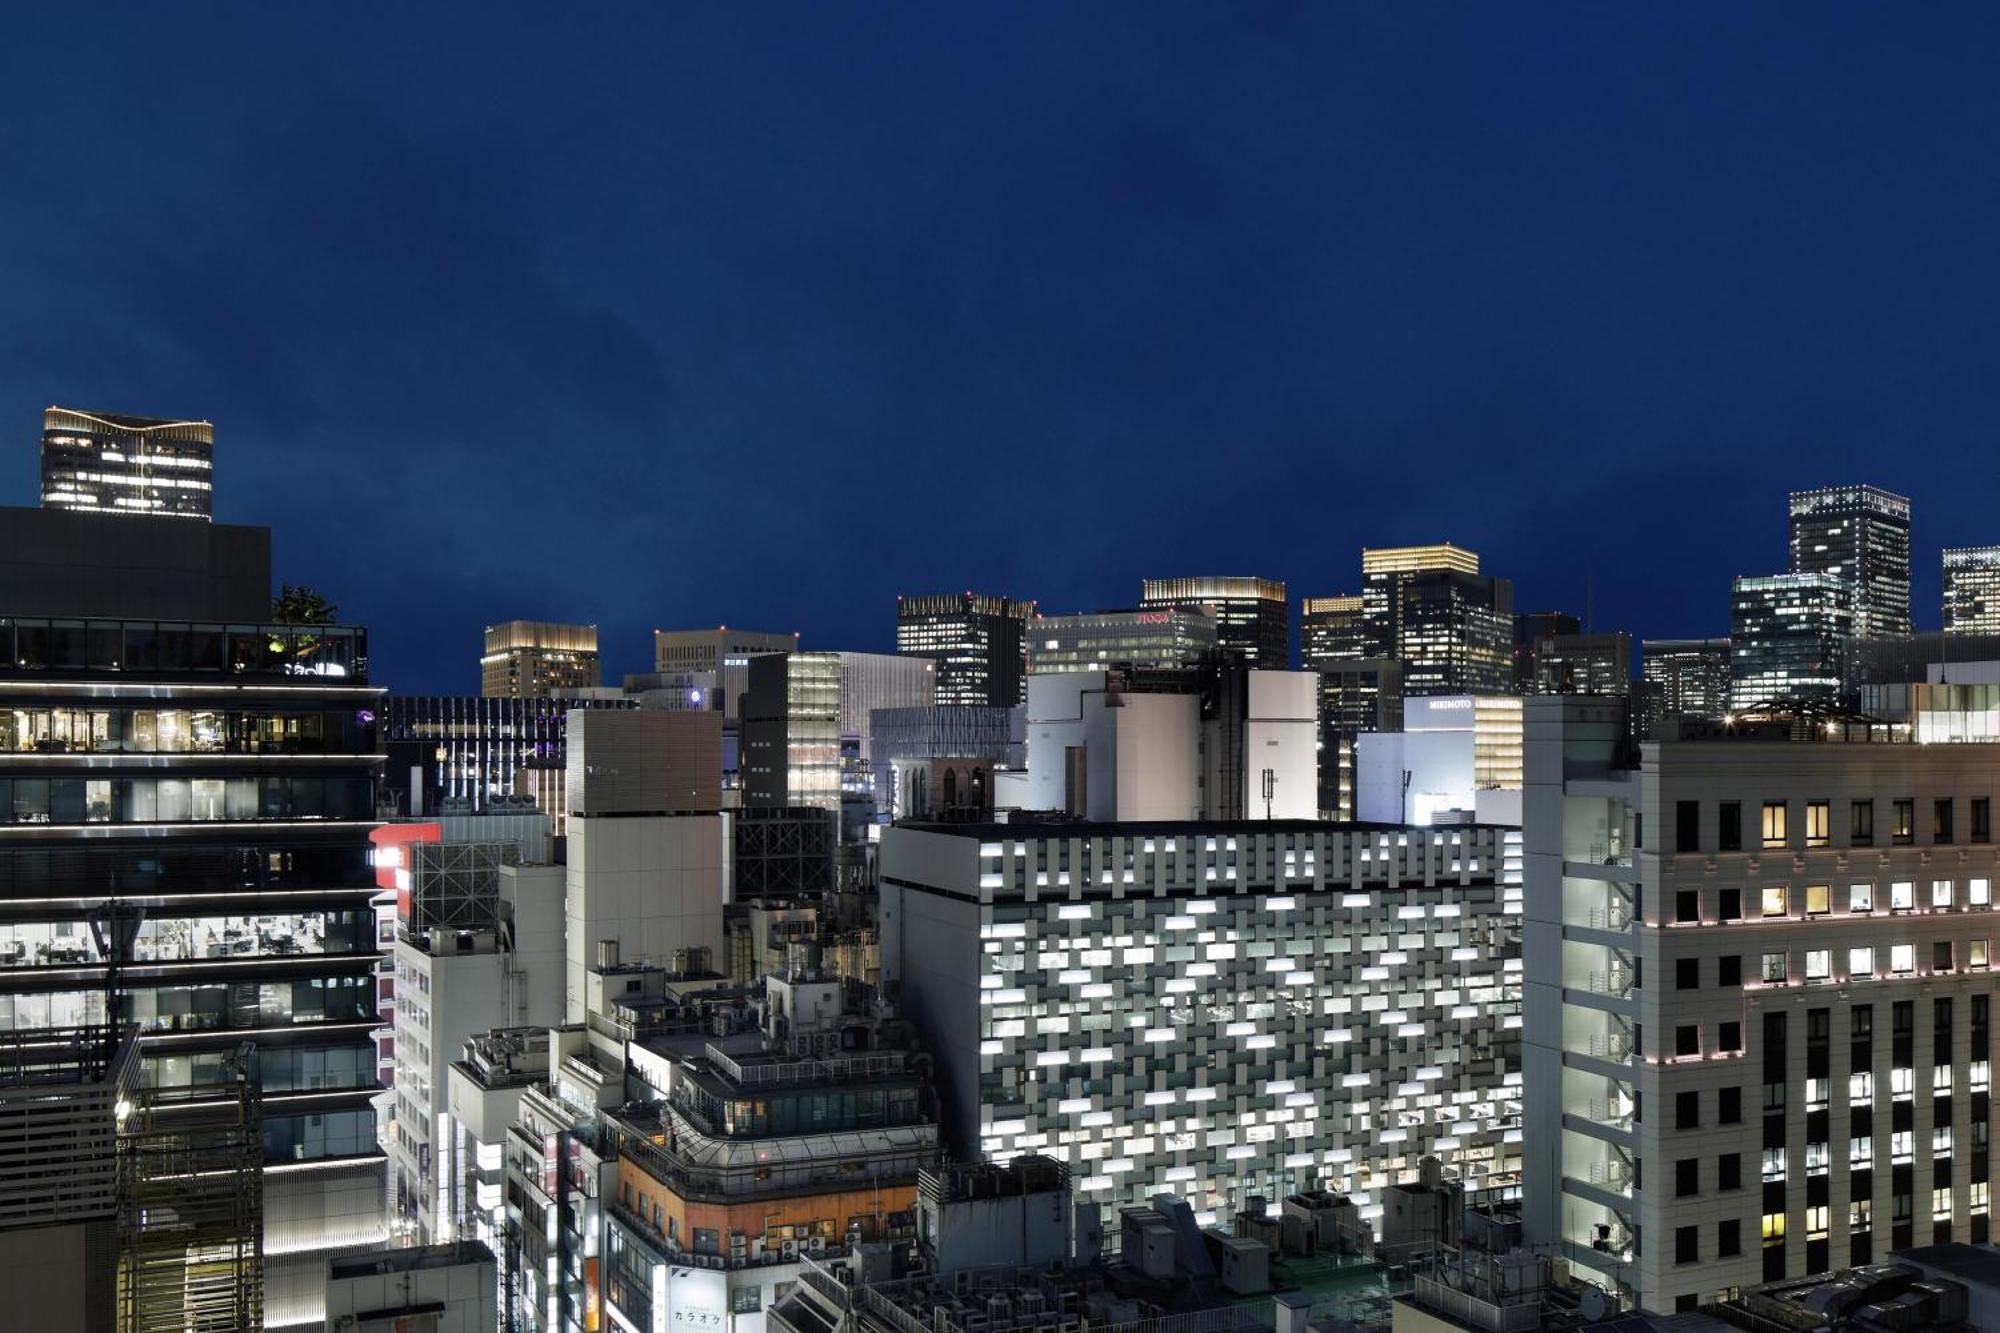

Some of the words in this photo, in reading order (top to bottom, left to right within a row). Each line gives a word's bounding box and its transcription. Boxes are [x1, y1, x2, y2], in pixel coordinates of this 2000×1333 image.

[1429, 700, 1472, 710] MIKIMOTO
[675, 1312, 721, 1325] カラオケ
